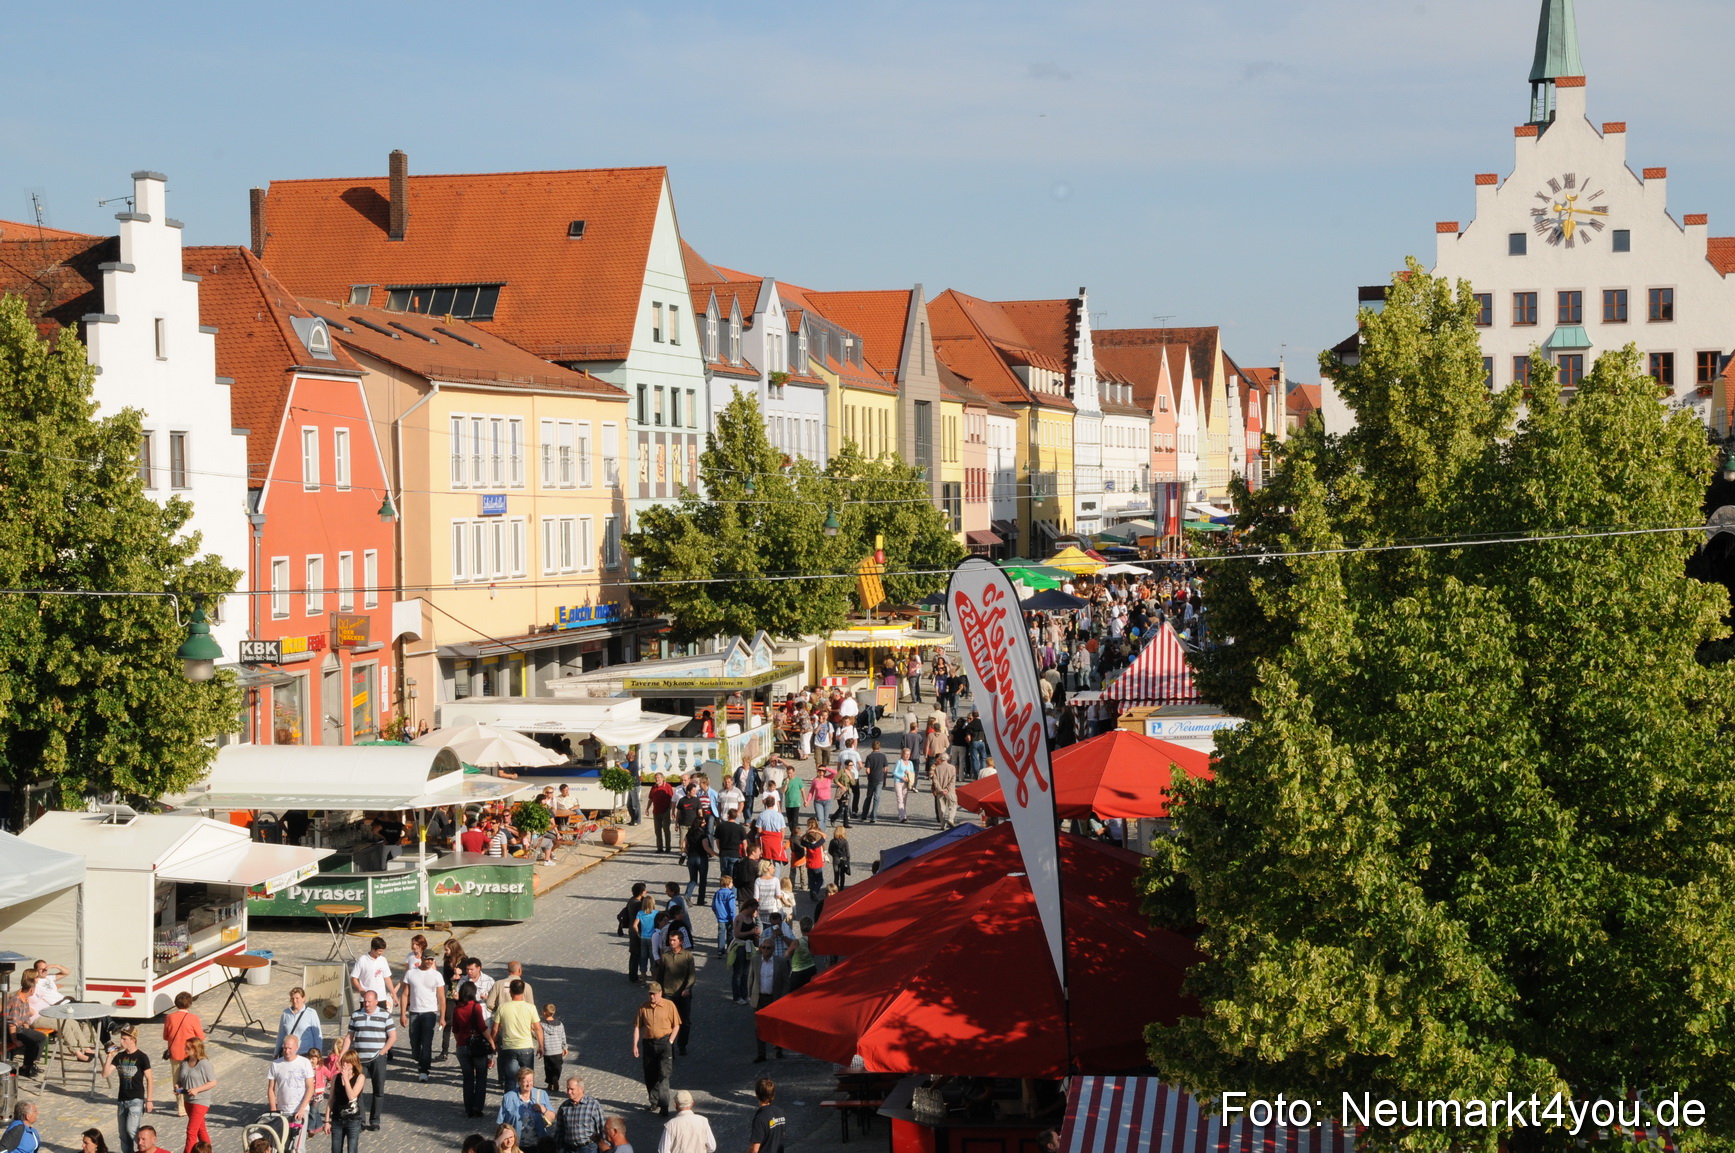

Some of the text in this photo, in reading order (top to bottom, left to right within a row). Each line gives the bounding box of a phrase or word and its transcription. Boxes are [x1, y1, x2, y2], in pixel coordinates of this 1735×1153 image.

[241, 642, 277, 655] KBK
[662, 680, 694, 688] Mykonos
[287, 884, 365, 904] Pyraser
[465, 881, 525, 897] Pyraser
